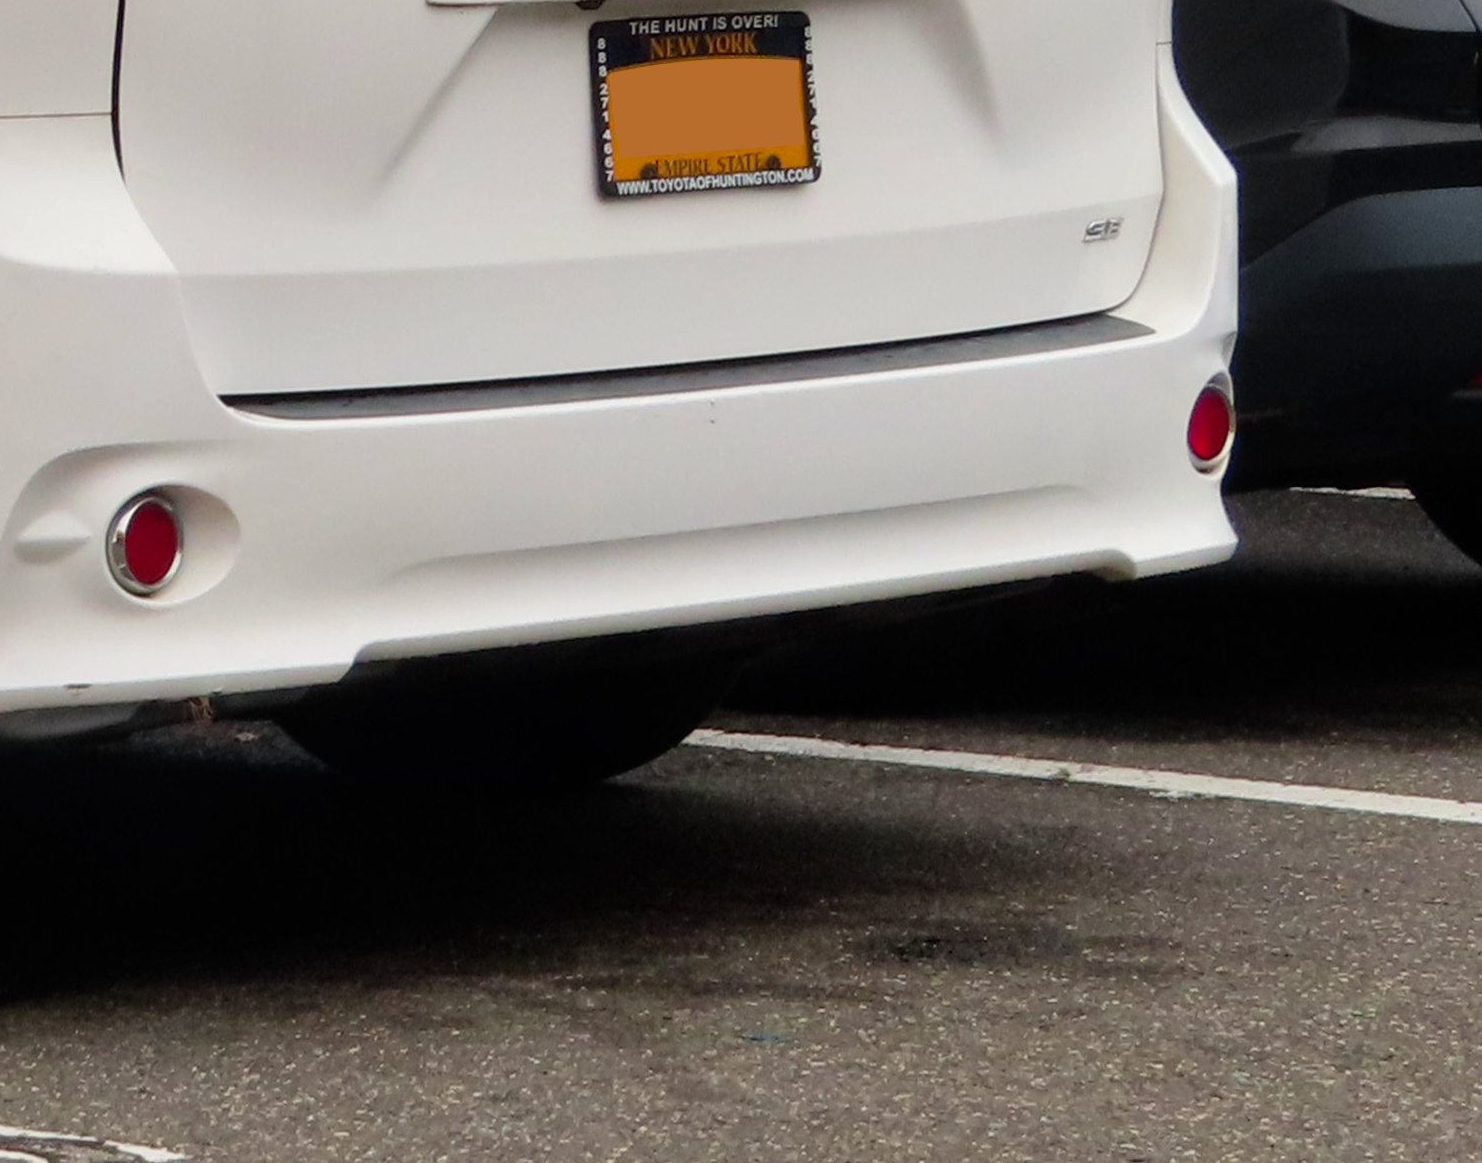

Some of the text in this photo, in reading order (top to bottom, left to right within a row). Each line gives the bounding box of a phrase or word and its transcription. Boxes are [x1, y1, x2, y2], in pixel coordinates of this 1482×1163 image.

[629, 14, 779, 35] THE HUNT IS OVER!
[650, 32, 758, 60] NEW YORK
[717, 152, 762, 173] STATE
[617, 167, 814, 195] WWW.TOYOTAOFHUNTINGTON.COM
